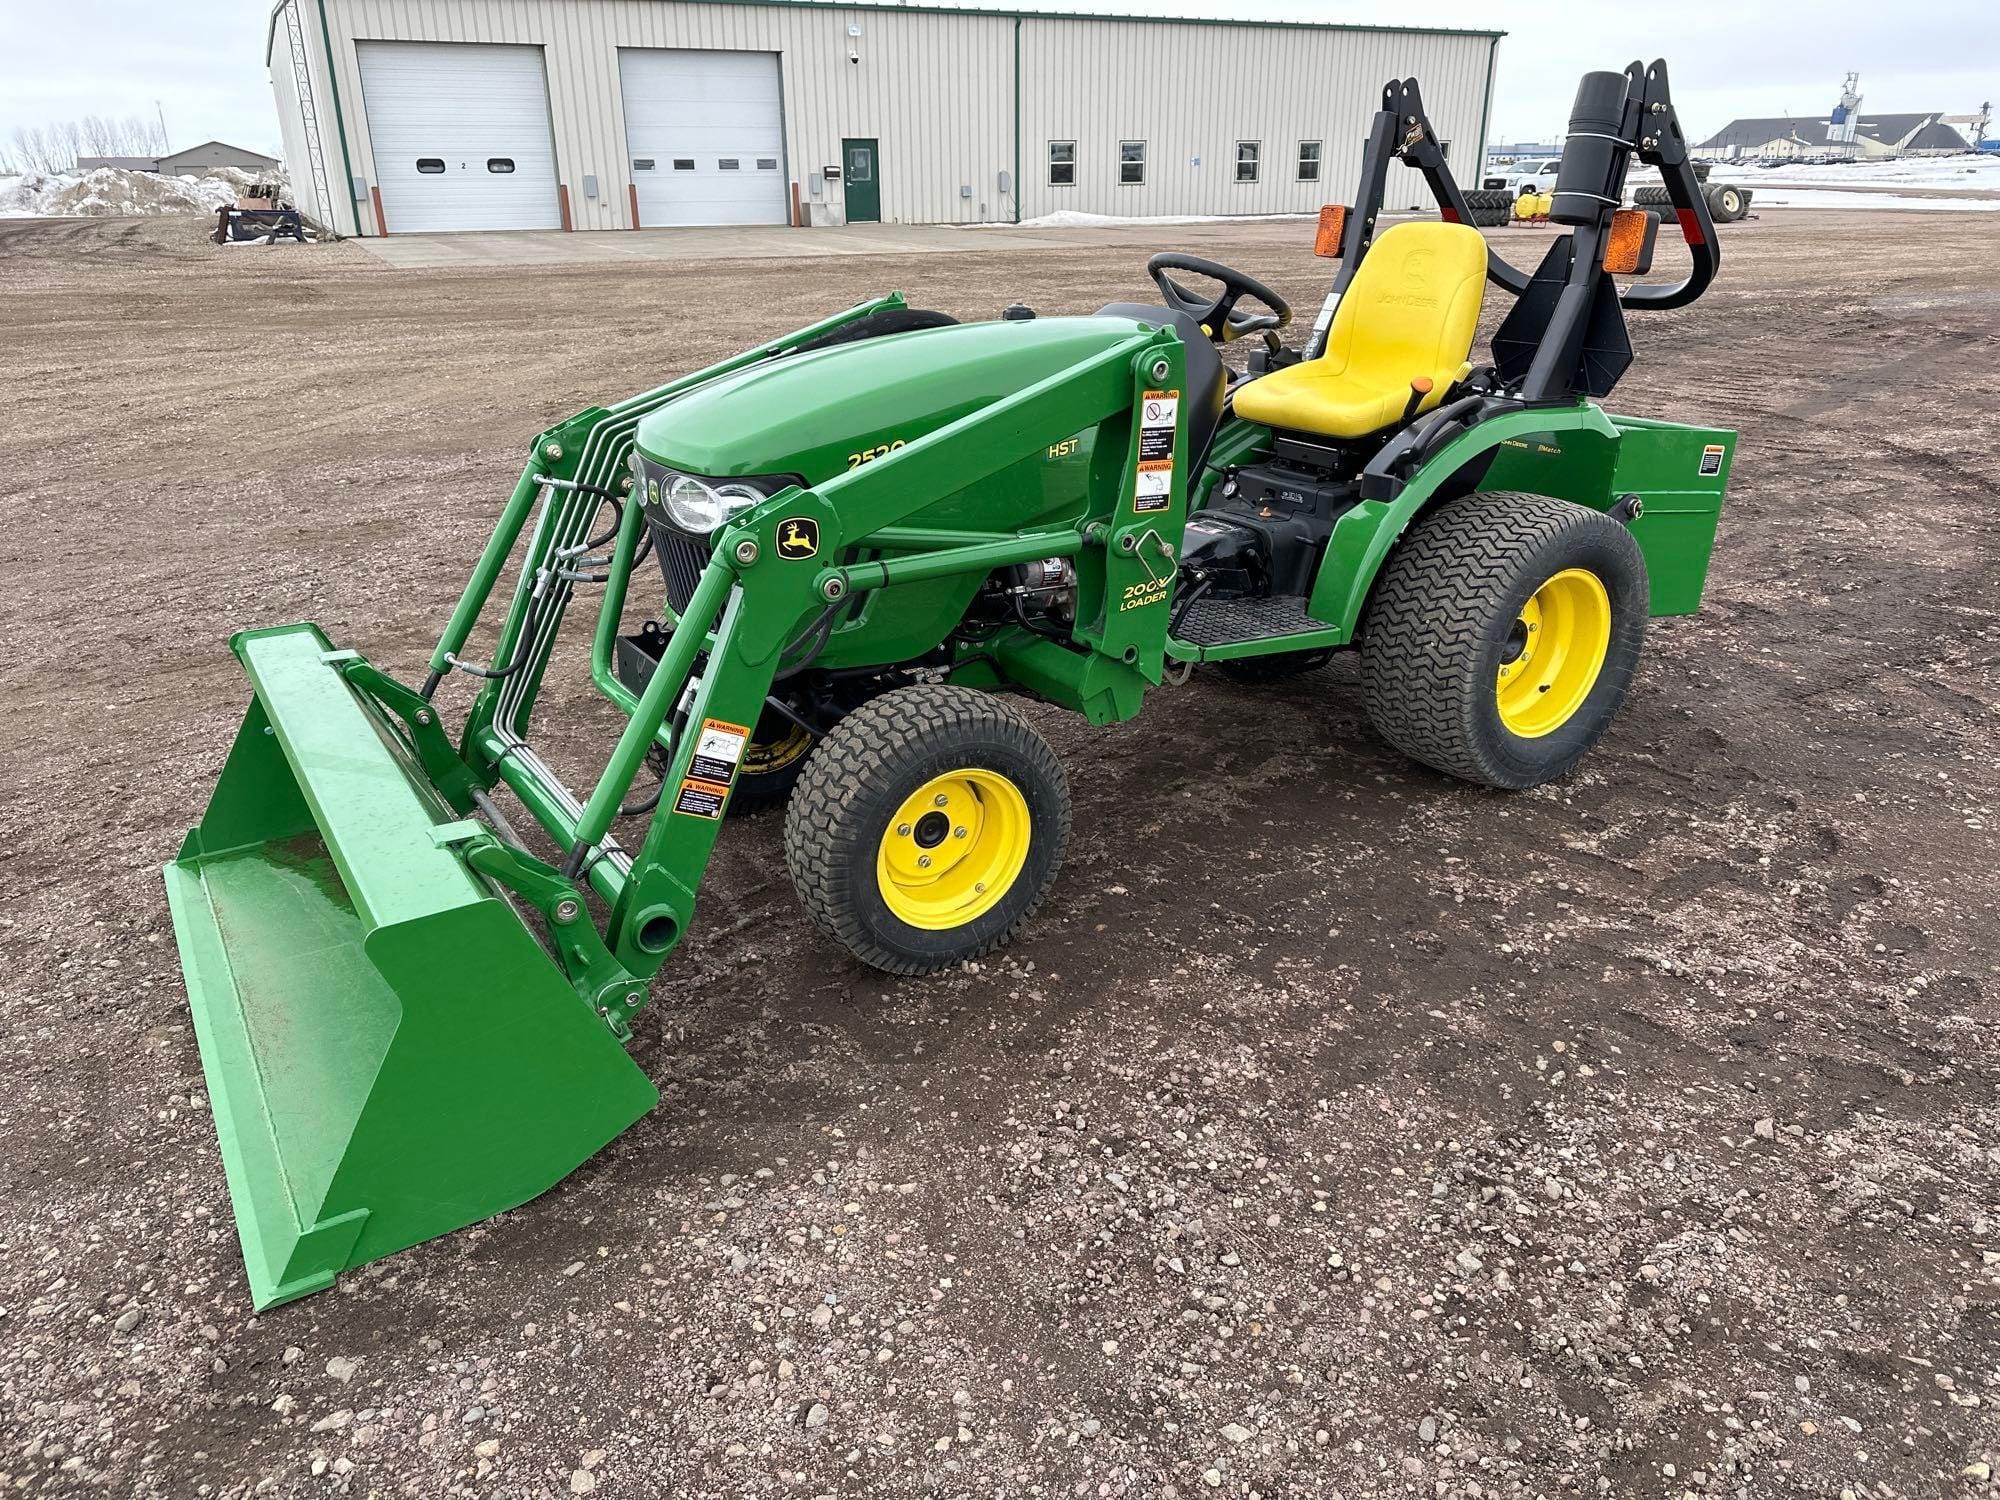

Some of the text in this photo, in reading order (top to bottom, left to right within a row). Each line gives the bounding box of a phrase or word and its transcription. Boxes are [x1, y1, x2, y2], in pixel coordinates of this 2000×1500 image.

[461, 162, 467, 170] 2
[1150, 391, 1178, 400] WARNING
[1048, 439, 1078, 458] HST
[1144, 463, 1172, 472] WARNING
[1120, 590, 1167, 611] LOADER
[716, 723, 745, 735] WARNING
[695, 784, 724, 795] WARNING
